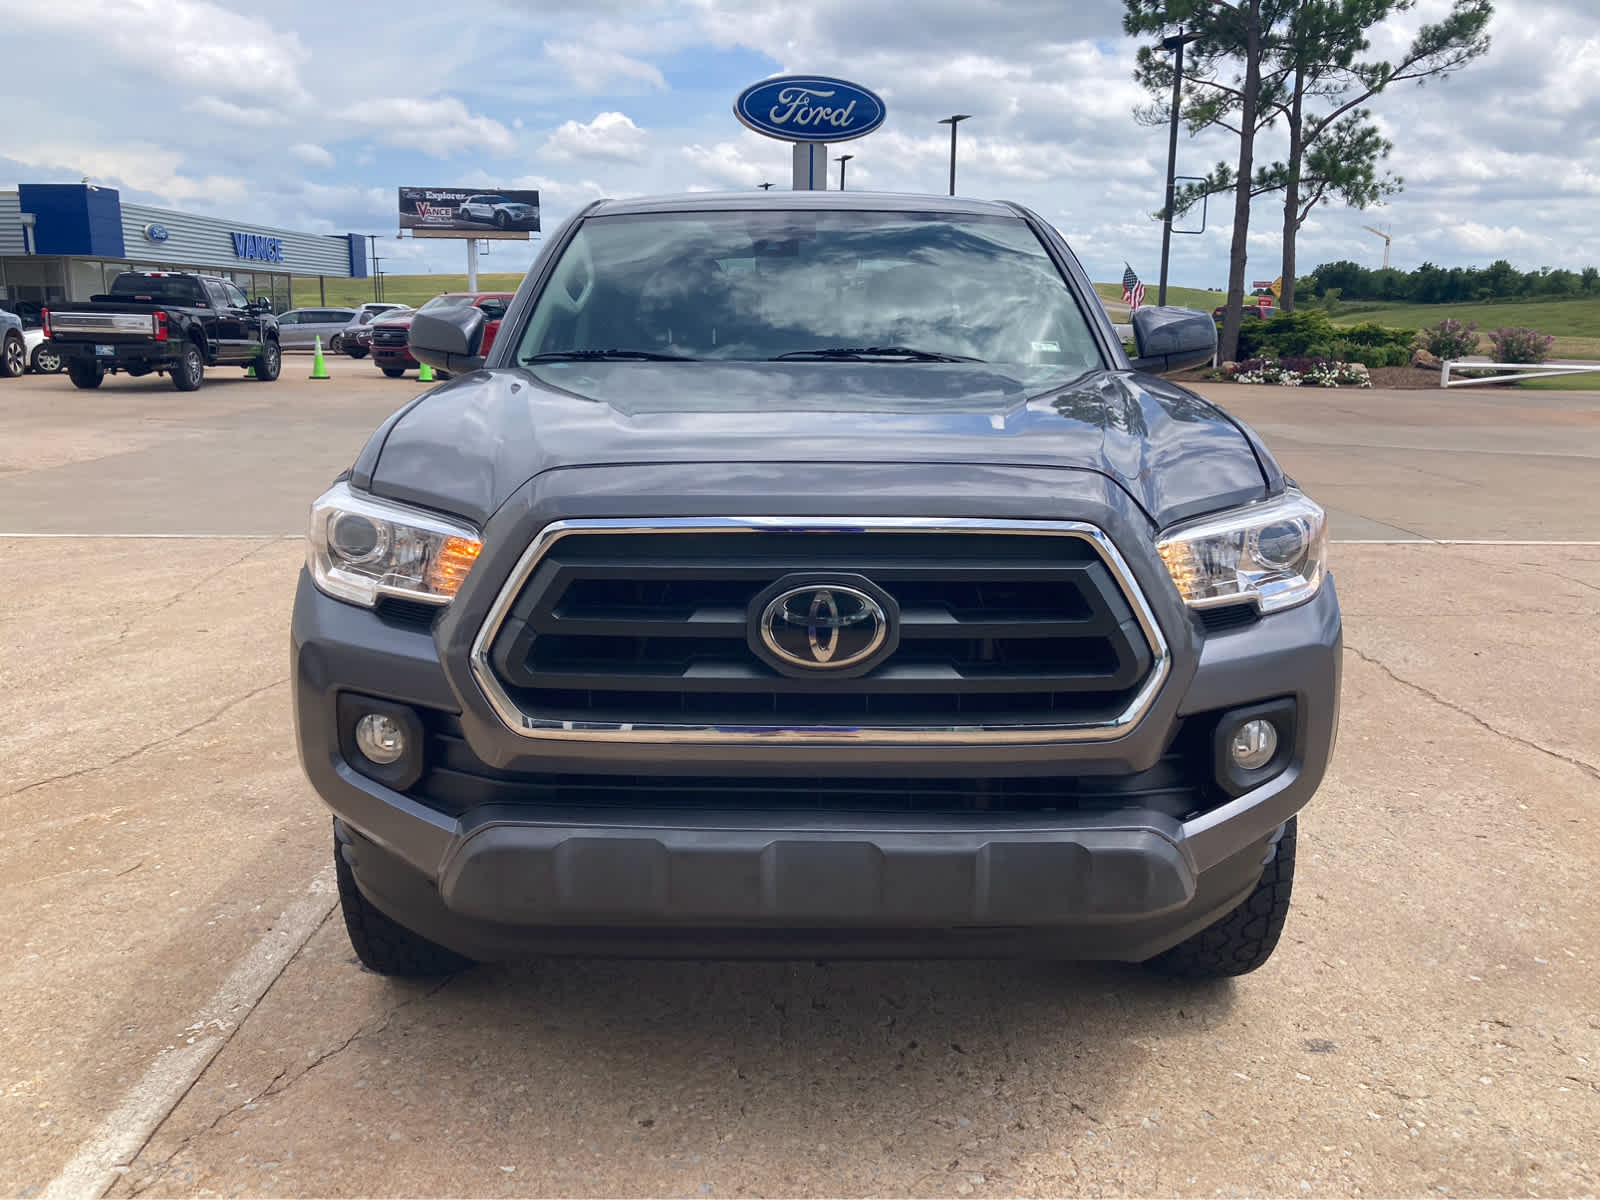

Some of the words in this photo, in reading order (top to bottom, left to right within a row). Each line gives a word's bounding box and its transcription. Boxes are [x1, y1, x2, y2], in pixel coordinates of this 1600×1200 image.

[769, 87, 857, 127] Ford
[425, 191, 466, 201] Explorer
[416, 201, 452, 220] VANCE
[230, 231, 285, 262] VANCE
